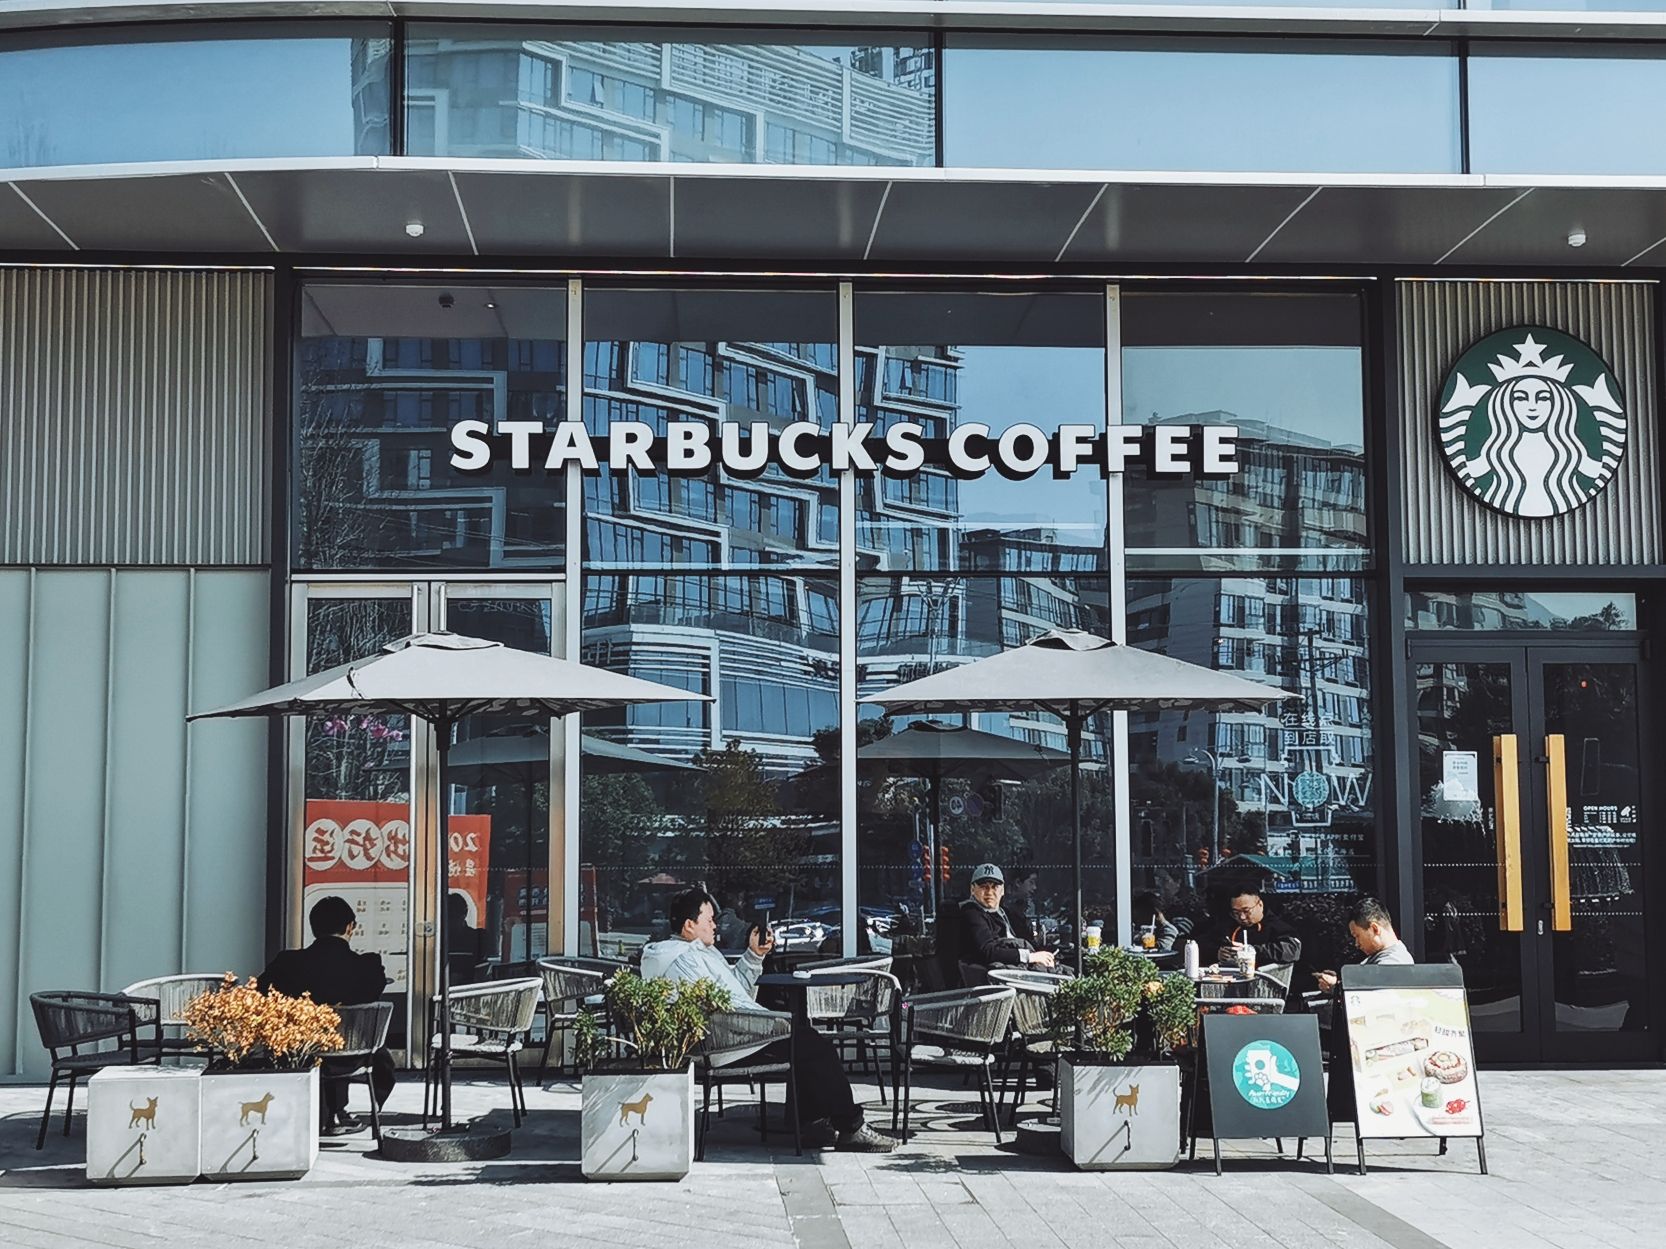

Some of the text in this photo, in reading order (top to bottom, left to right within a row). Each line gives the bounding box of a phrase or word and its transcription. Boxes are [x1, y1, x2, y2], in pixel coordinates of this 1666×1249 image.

[449, 419, 1239, 473] STARBUCKS COFFEE
[1283, 730, 1336, 745] 到店取
